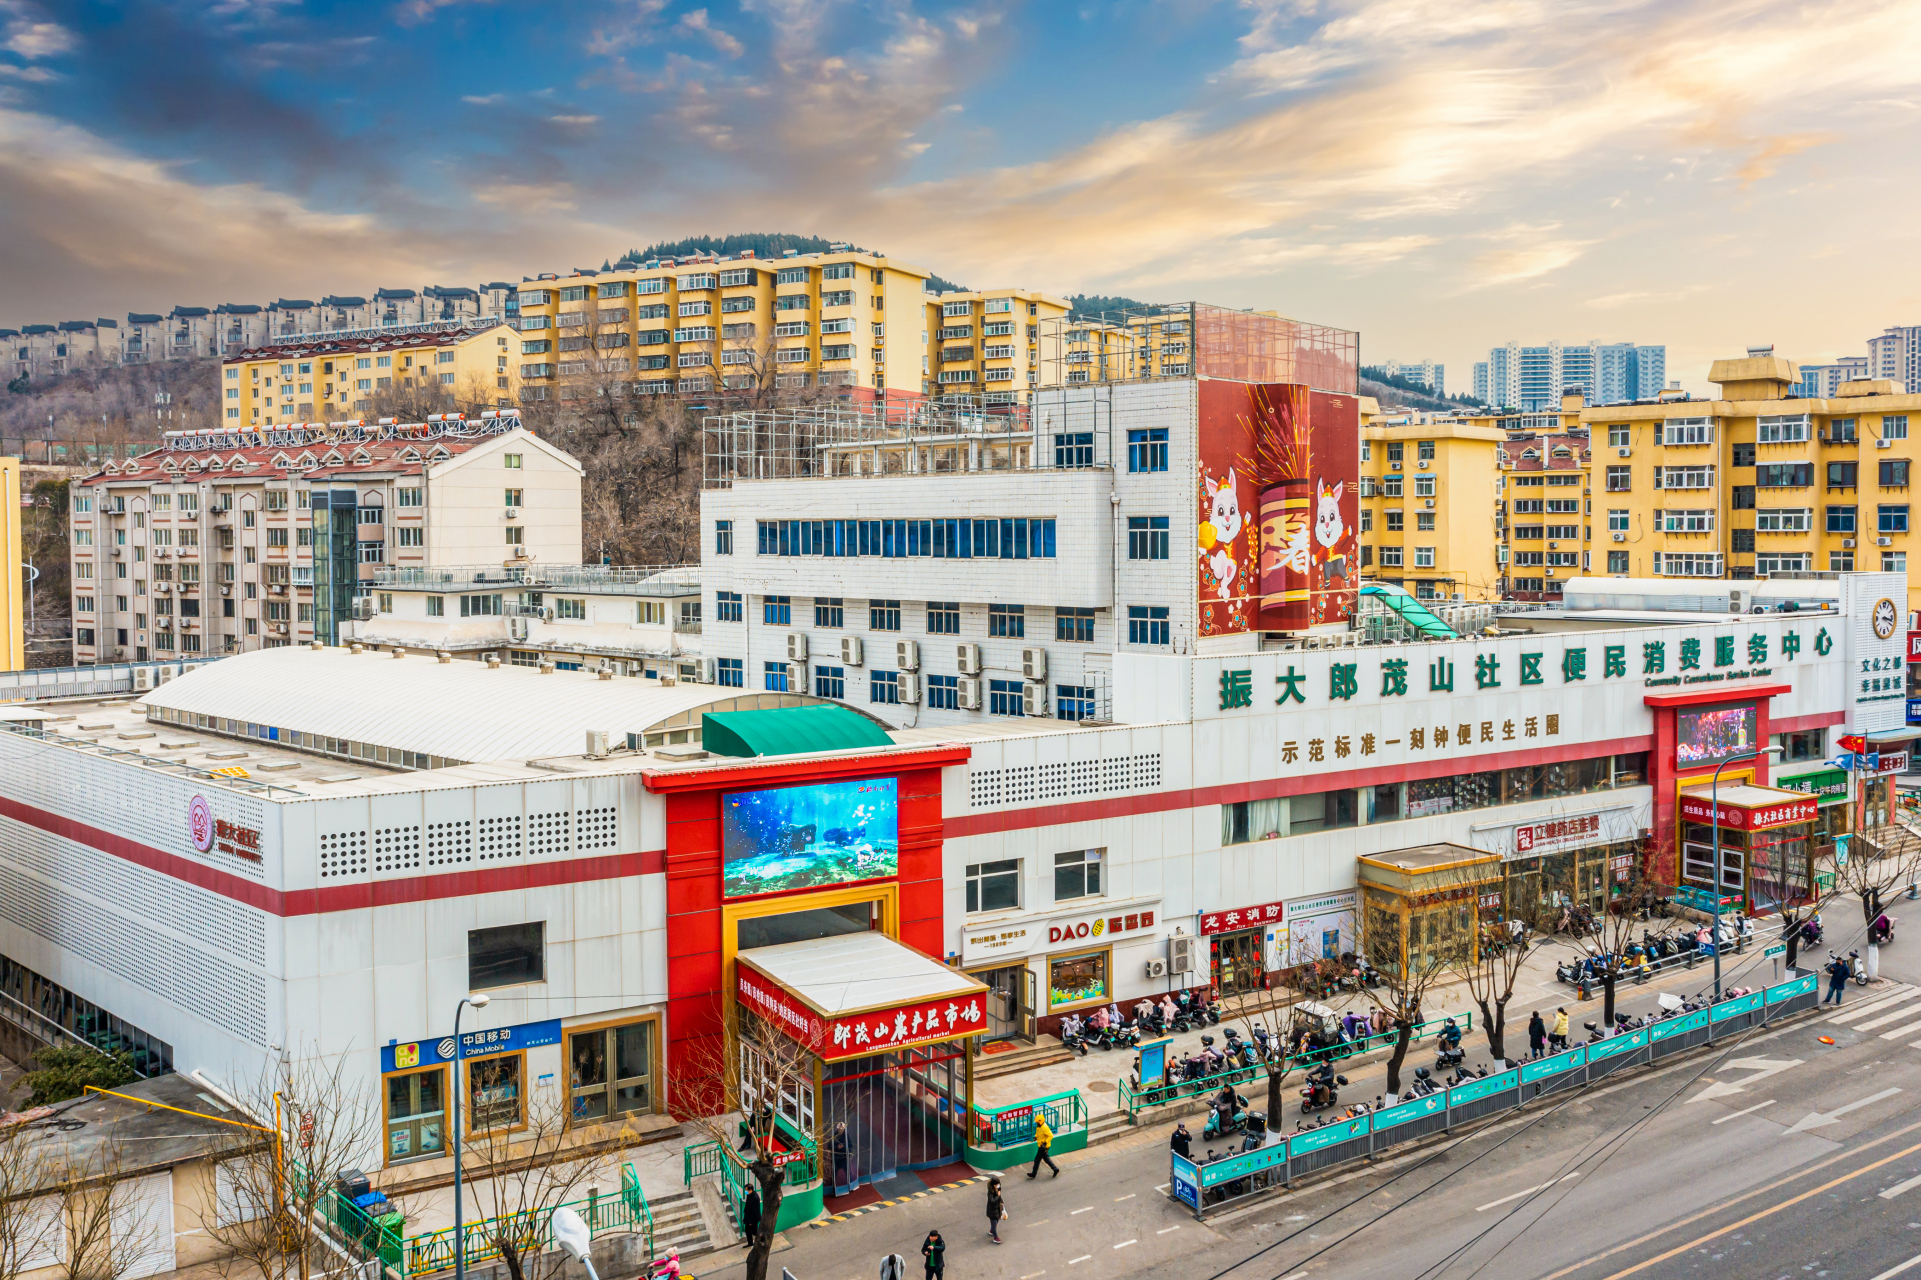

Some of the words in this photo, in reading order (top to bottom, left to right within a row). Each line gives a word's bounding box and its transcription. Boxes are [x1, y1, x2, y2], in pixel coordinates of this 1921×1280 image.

[1266, 523, 1310, 575] 春
[1219, 626, 1833, 711] 振大郎茂山社区便民消费服务中心
[1861, 656, 1902, 673] 文化之都
[1281, 713, 1560, 765] 示范标准一刻钟便民生活圈
[216, 818, 259, 849] 振大社区
[1535, 815, 1600, 841] 立健药店连锁
[1204, 905, 1281, 929] 龙安消防
[1049, 922, 1090, 943] DAO
[463, 1028, 511, 1046] 中国移动
[465, 1047, 484, 1056] China
[484, 1043, 505, 1053] Mobile
[1176, 1179, 1183, 1195] P
